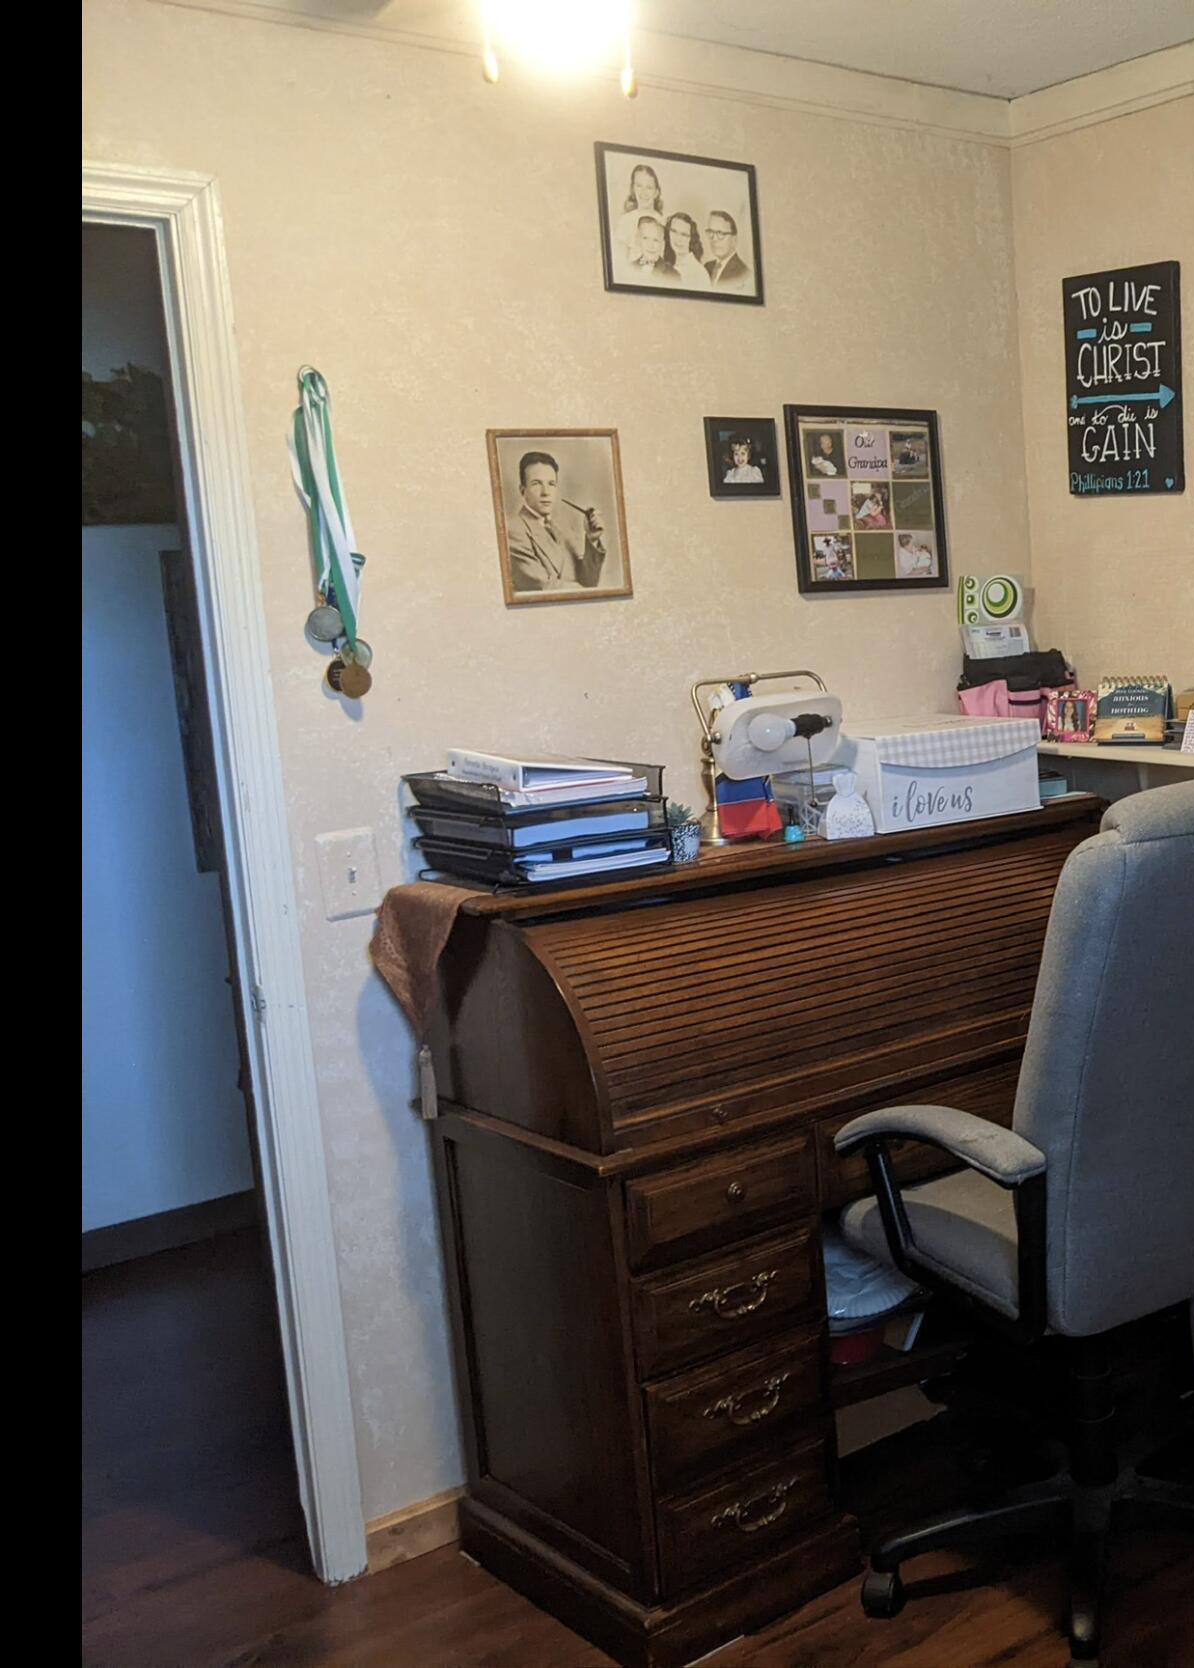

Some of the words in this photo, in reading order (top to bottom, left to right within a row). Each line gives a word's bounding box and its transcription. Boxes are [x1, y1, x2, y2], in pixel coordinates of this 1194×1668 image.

[1072, 287, 1100, 319] TO
[1109, 281, 1161, 315] LIVE
[1098, 317, 1128, 343] is
[1077, 341, 1167, 388] CHRIST
[1092, 409, 1109, 426] to
[1117, 405, 1137, 423] die
[1144, 406, 1158, 420] is
[1081, 422, 1157, 463] GAIN
[848, 455, 888, 473] Grandpa
[1127, 469, 1150, 489] 1:21
[892, 796, 904, 818] i
[906, 780, 949, 823] love
[951, 786, 973, 813] us
